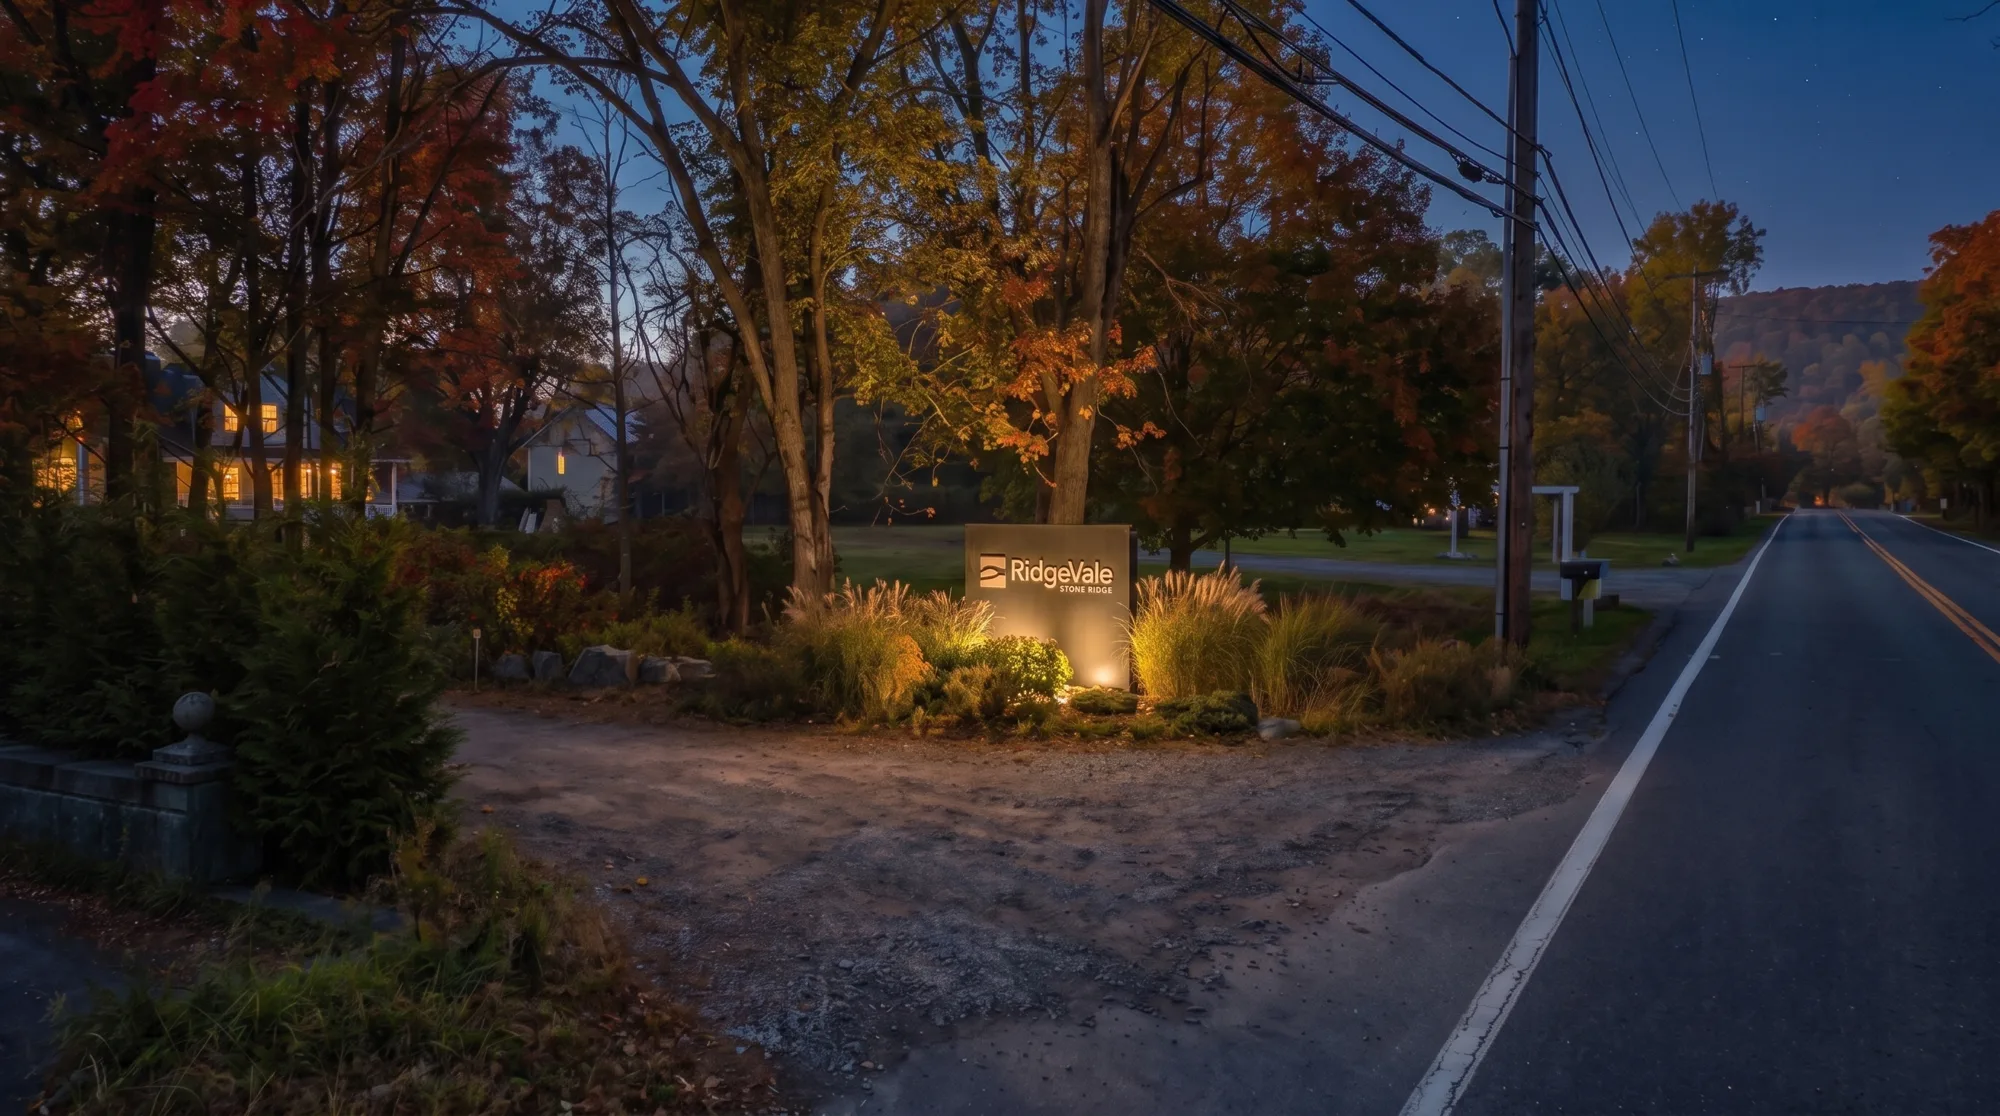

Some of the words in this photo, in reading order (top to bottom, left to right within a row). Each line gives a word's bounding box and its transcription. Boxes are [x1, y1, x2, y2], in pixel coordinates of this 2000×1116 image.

[1011, 559, 1113, 589] RidgeVale
[1059, 585, 1086, 593] STONE
[1087, 586, 1113, 594] RIDGE
